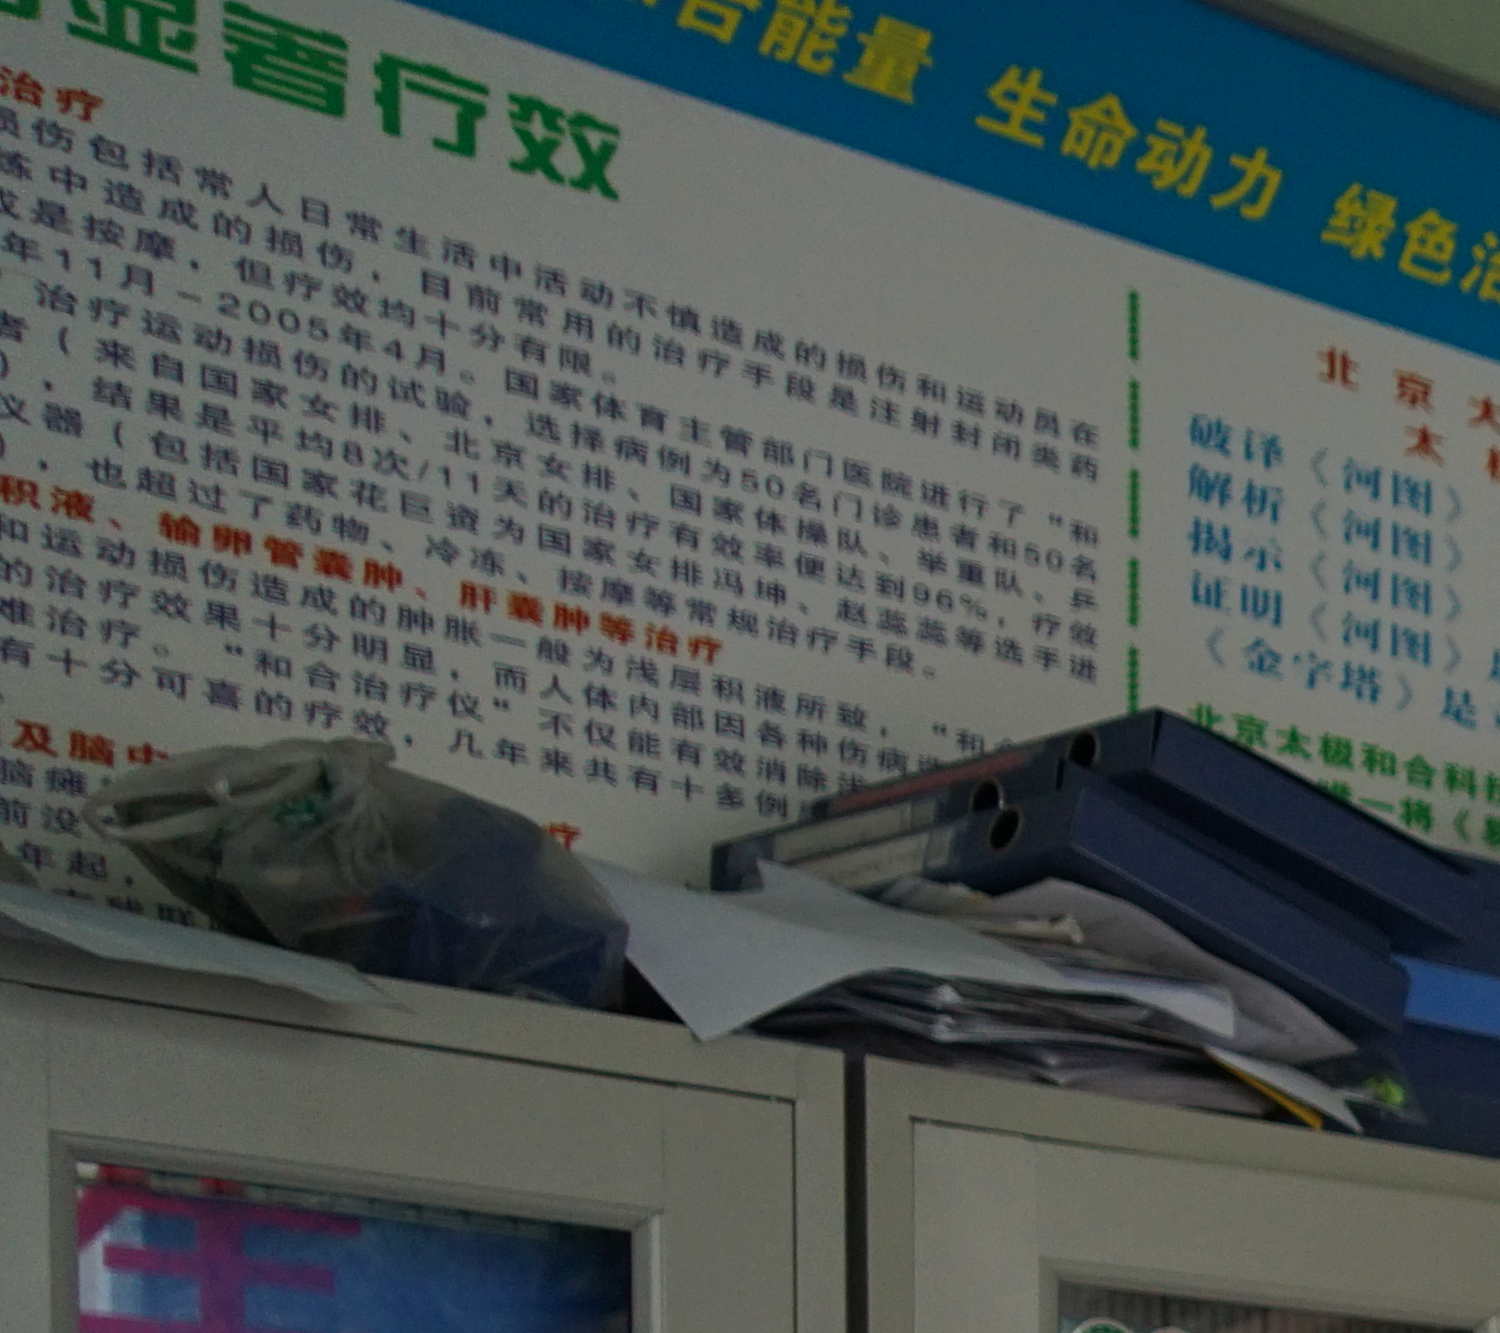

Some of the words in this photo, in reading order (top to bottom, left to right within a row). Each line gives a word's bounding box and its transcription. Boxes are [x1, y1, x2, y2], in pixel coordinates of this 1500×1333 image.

[0, 0, 622, 201] 显著疗效
[975, 68, 1283, 222] 生命动力
